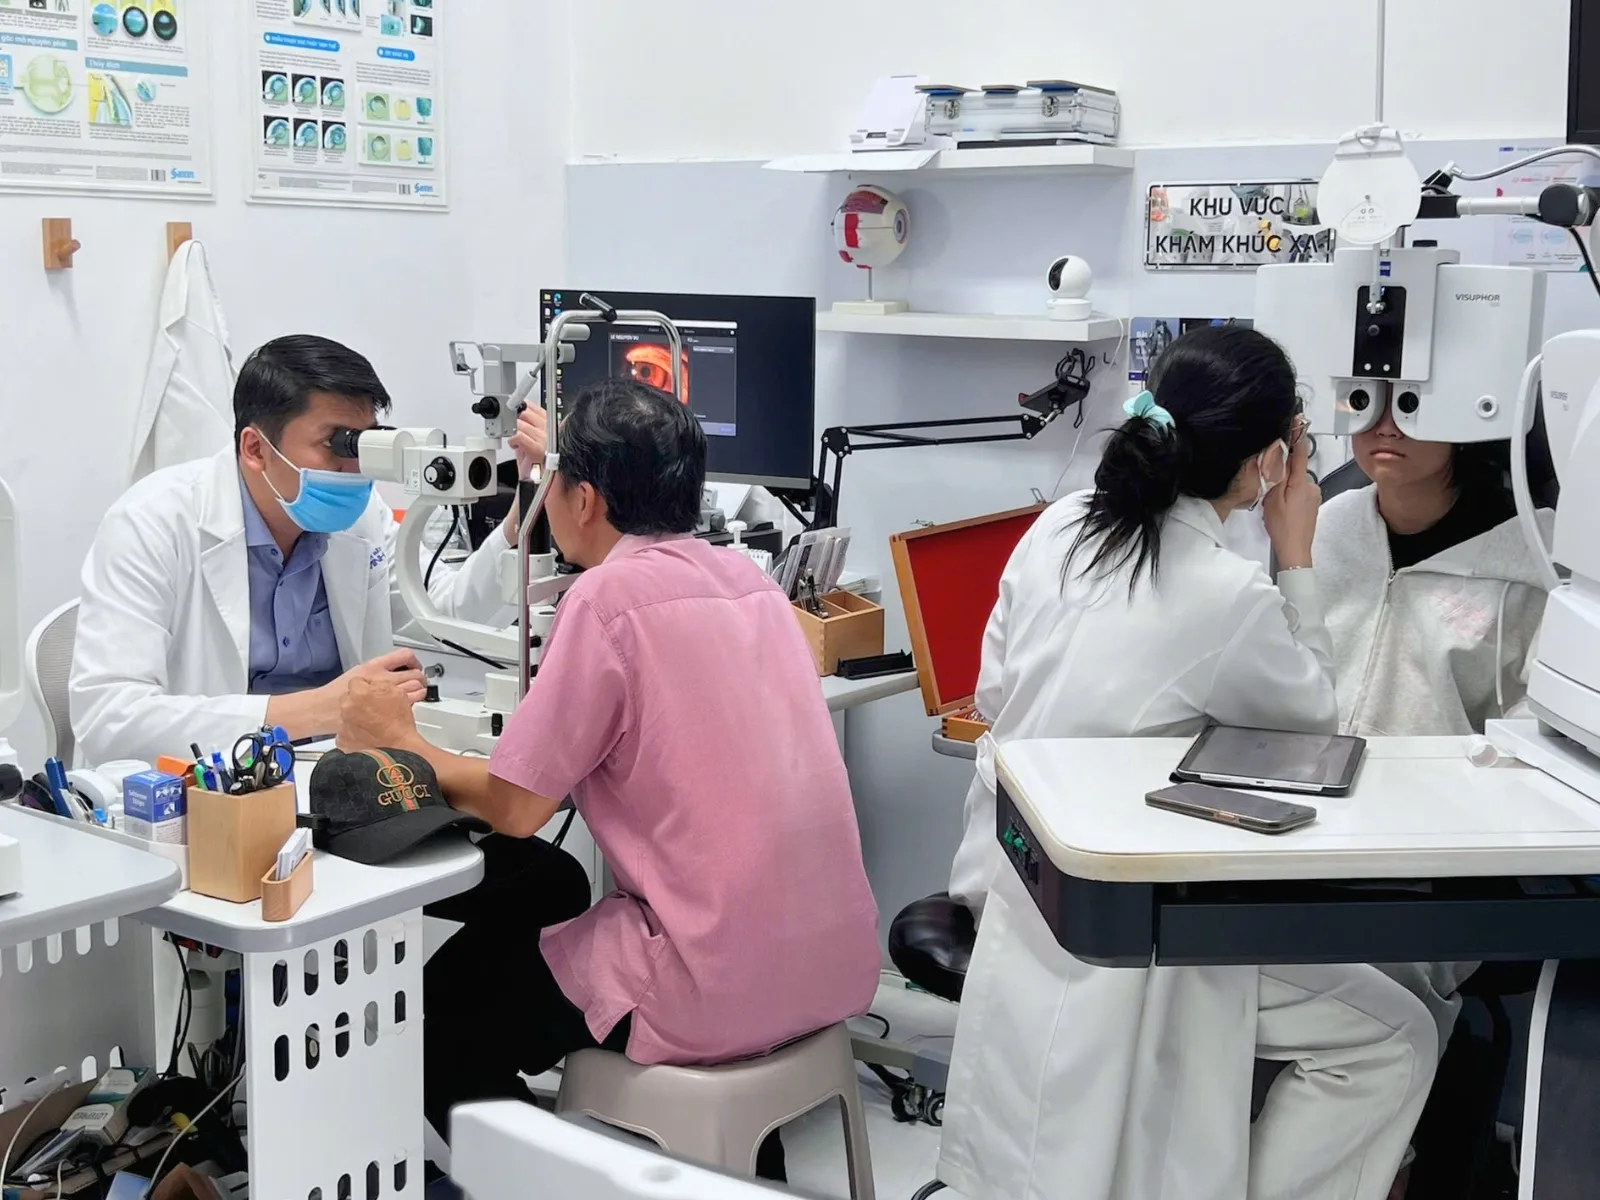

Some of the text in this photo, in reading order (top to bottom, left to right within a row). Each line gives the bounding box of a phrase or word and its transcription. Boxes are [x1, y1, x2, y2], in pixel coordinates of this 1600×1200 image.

[1190, 196, 1285, 220] KHU VỰC
[1156, 230, 1215, 253] KHÁM
[1222, 230, 1282, 253] KHÚC
[1455, 293, 1500, 301] VISUPHOR
[377, 784, 432, 806] GUCCI
